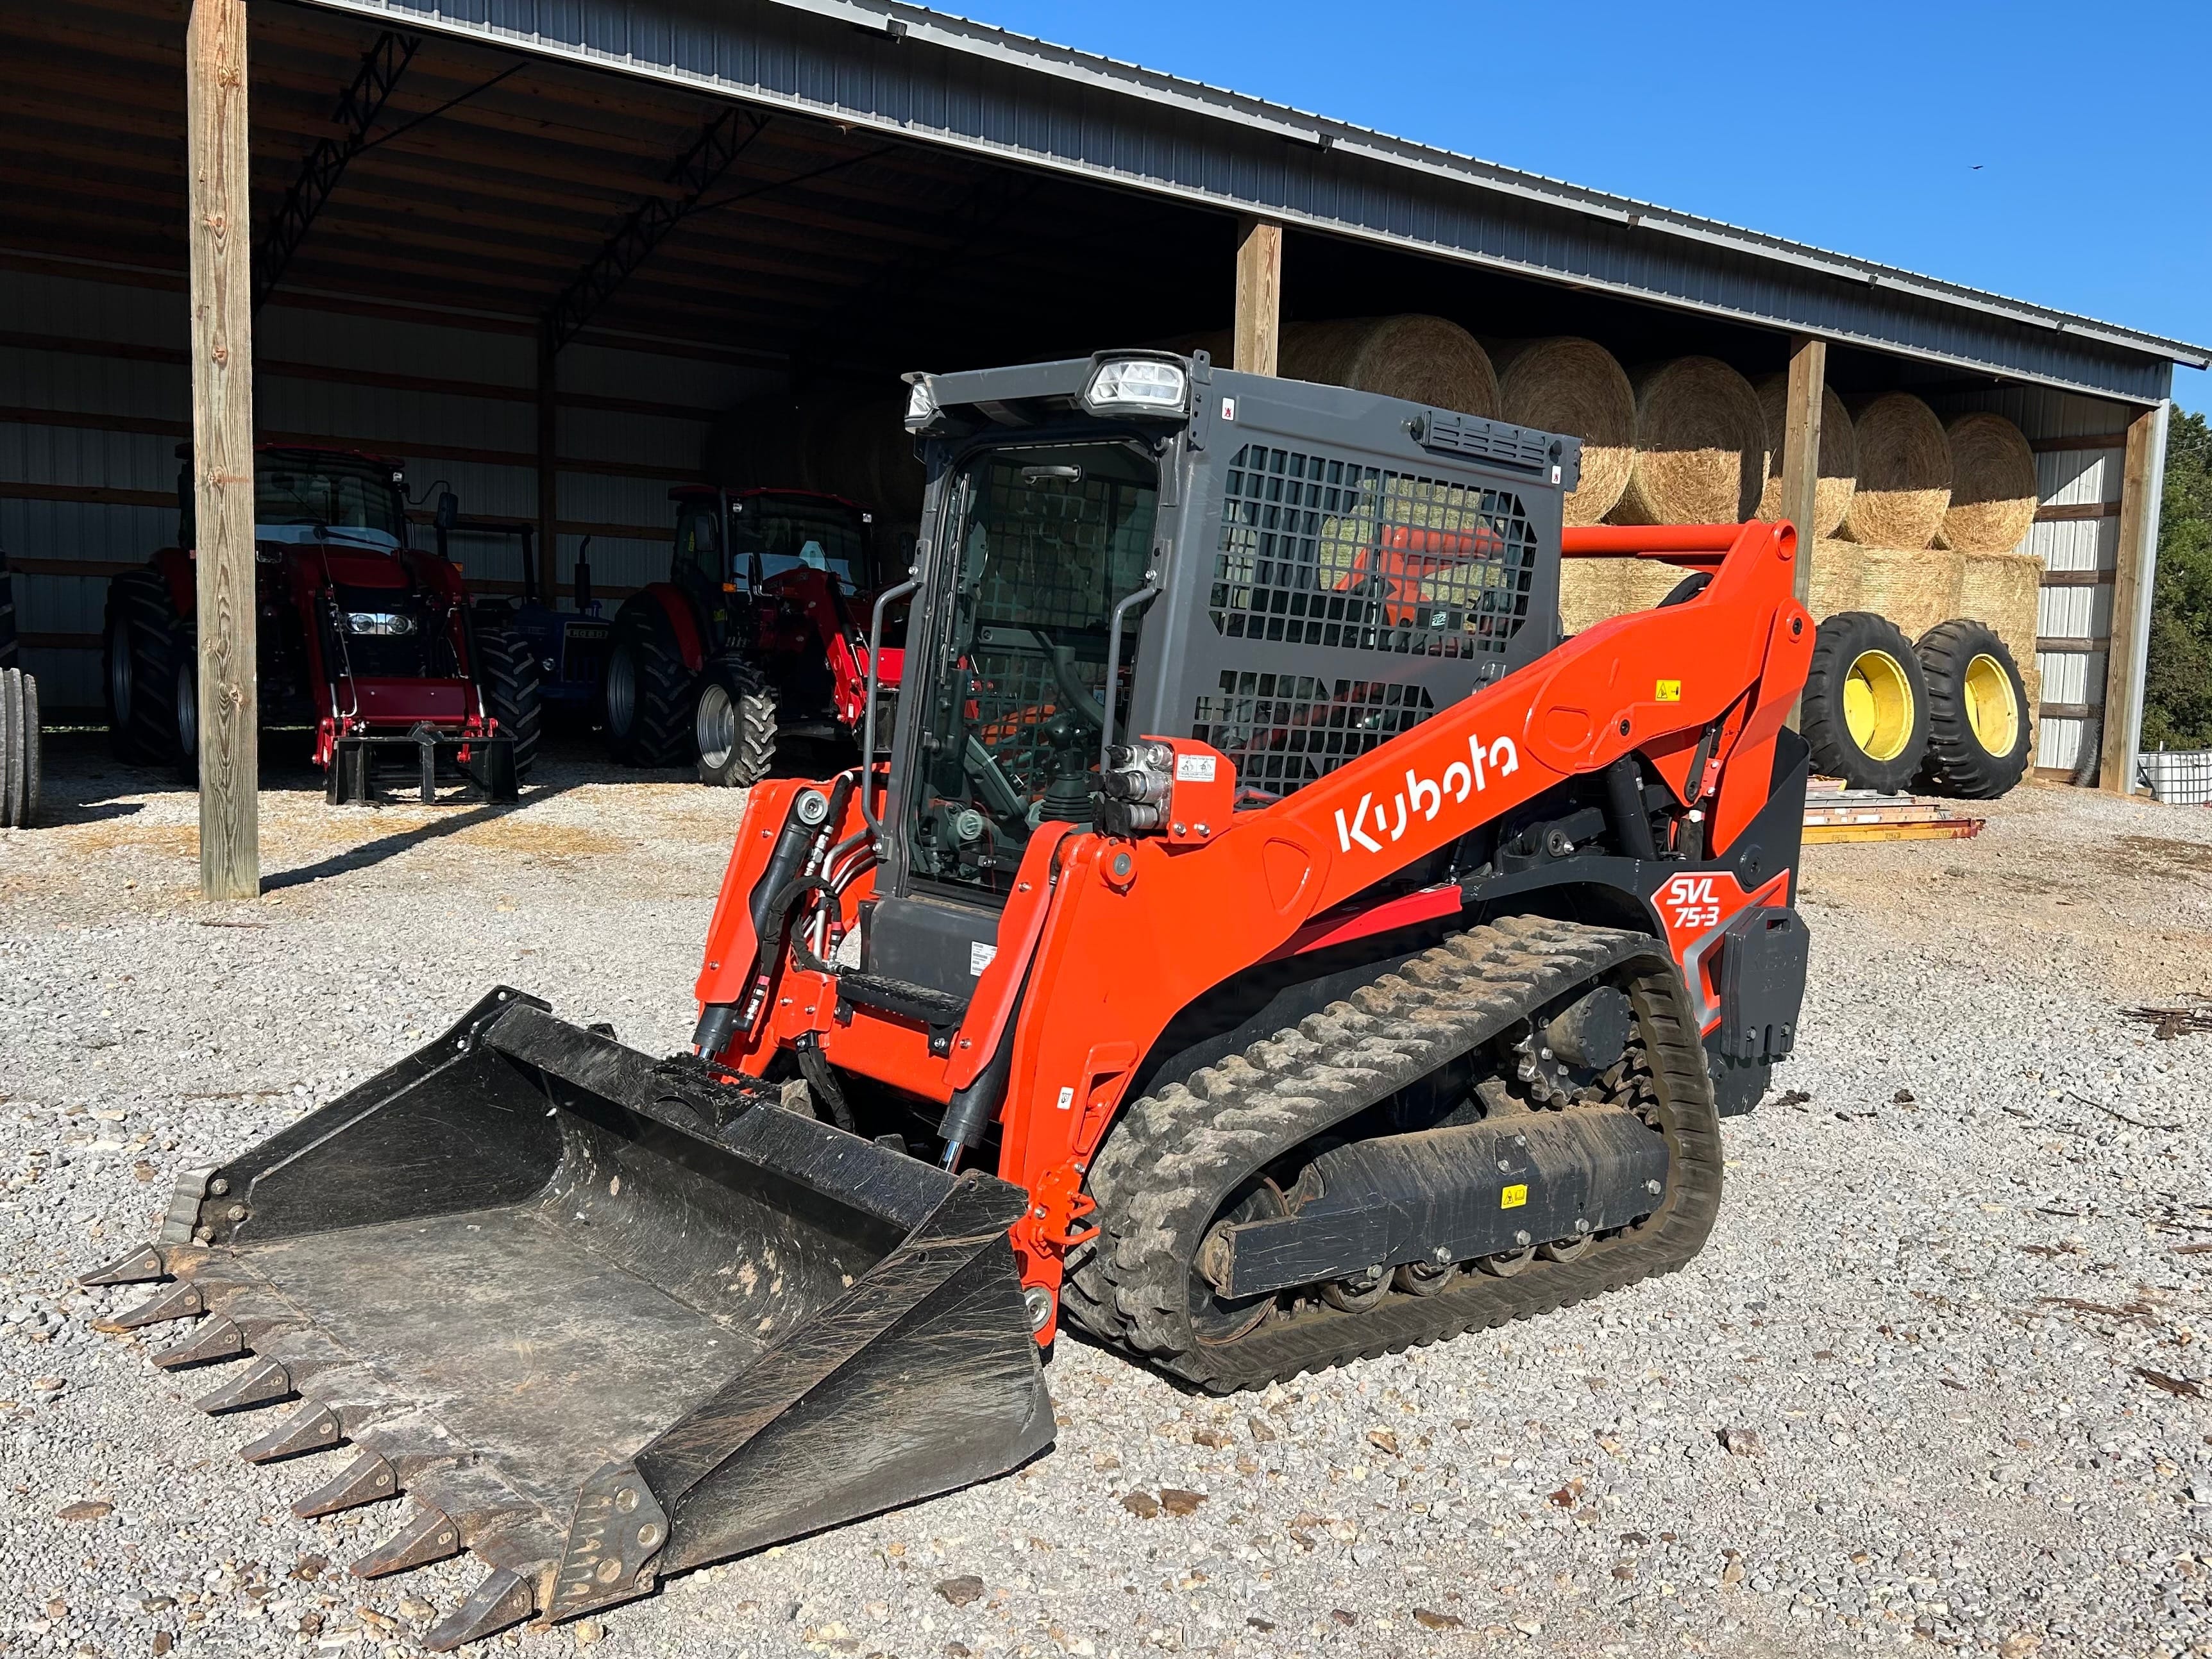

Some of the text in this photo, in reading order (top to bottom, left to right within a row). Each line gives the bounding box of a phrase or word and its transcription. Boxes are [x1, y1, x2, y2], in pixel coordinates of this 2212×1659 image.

[1334, 734, 1519, 854] Kubota
[1666, 878, 1719, 905] SVL
[1673, 906, 1720, 929] 75-3
